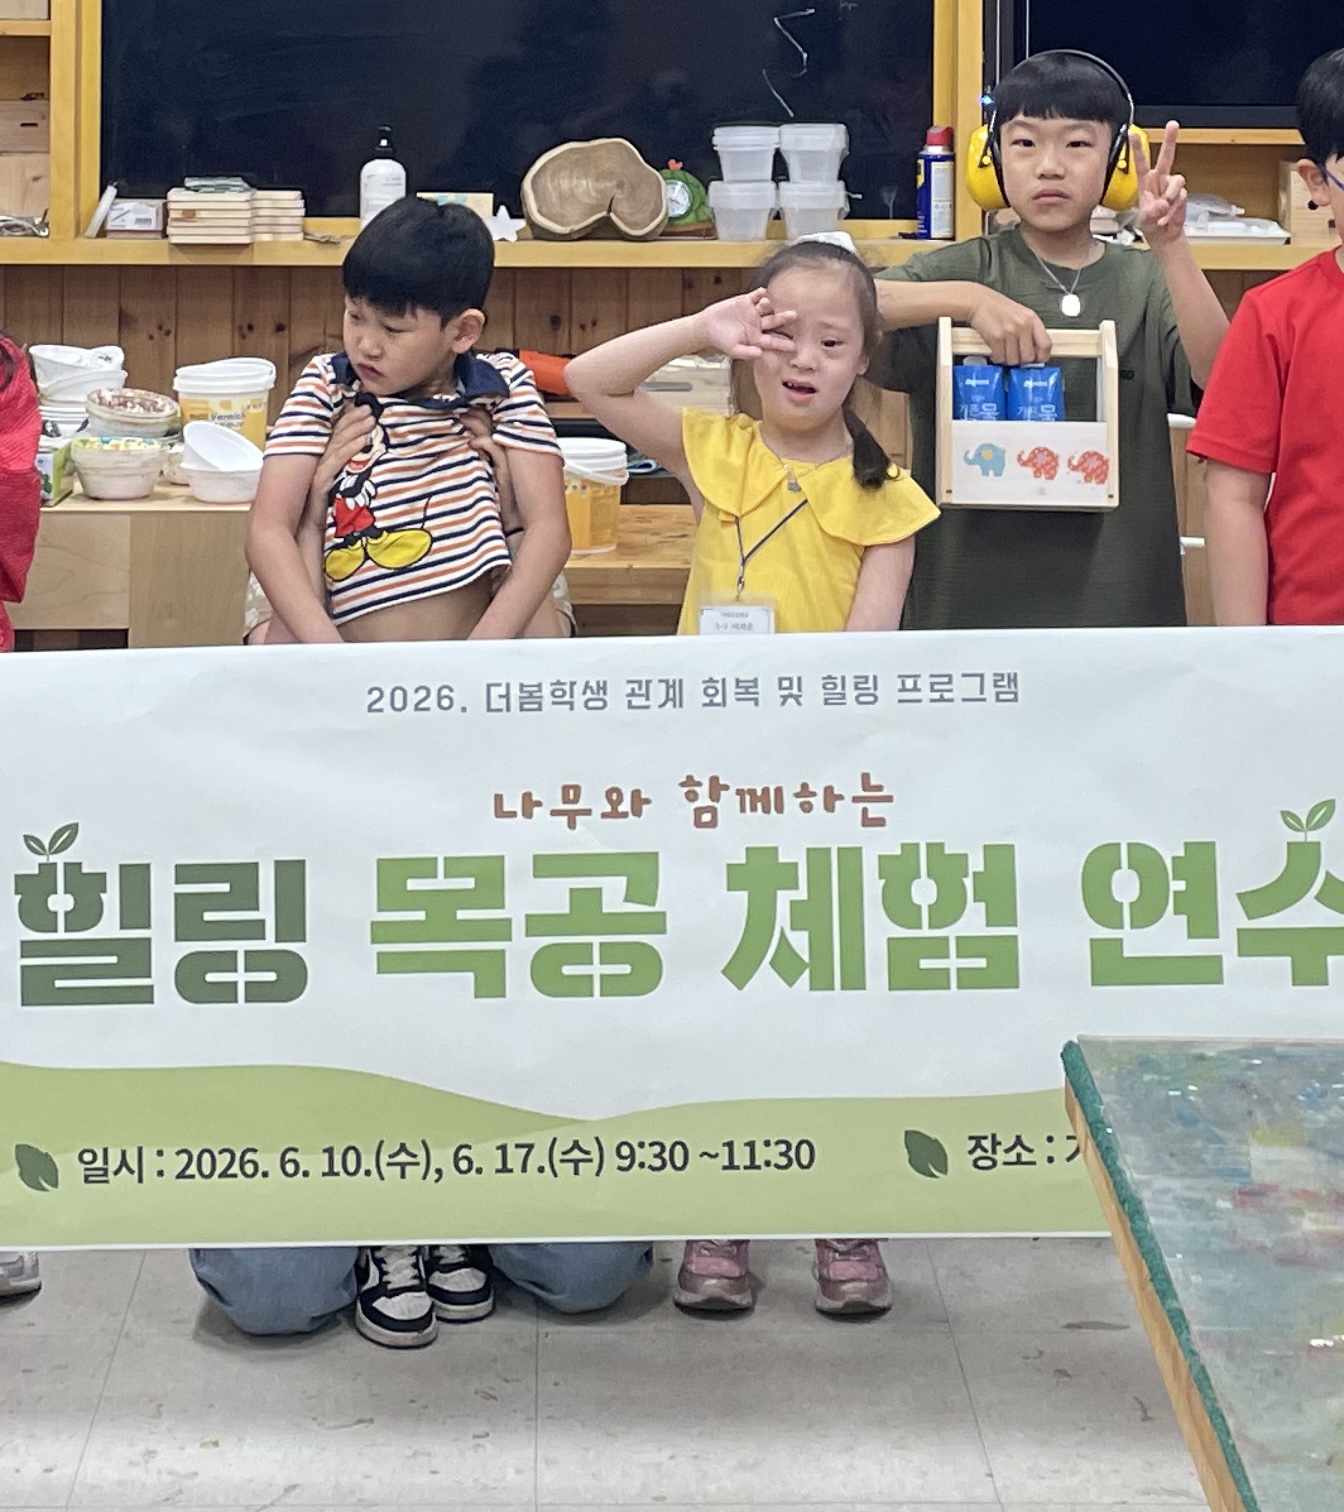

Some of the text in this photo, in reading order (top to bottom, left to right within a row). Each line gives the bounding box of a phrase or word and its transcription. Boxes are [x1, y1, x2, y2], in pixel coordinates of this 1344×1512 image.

[367, 671, 1019, 713] 2026. 더봄학생 관계 회복 및 힐링 프로그램
[494, 772, 894, 831] 나무와 함께하는
[13, 855, 309, 1006] 힐링
[369, 851, 668, 1000] 목공
[720, 841, 1020, 992] 체험
[174, 1147, 270, 1180] 2026.
[279, 1146, 310, 1179] 6.
[452, 1143, 484, 1176] 6.
[494, 1135, 605, 1179] 17.(수)
[615, 1140, 690, 1173] 9:30
